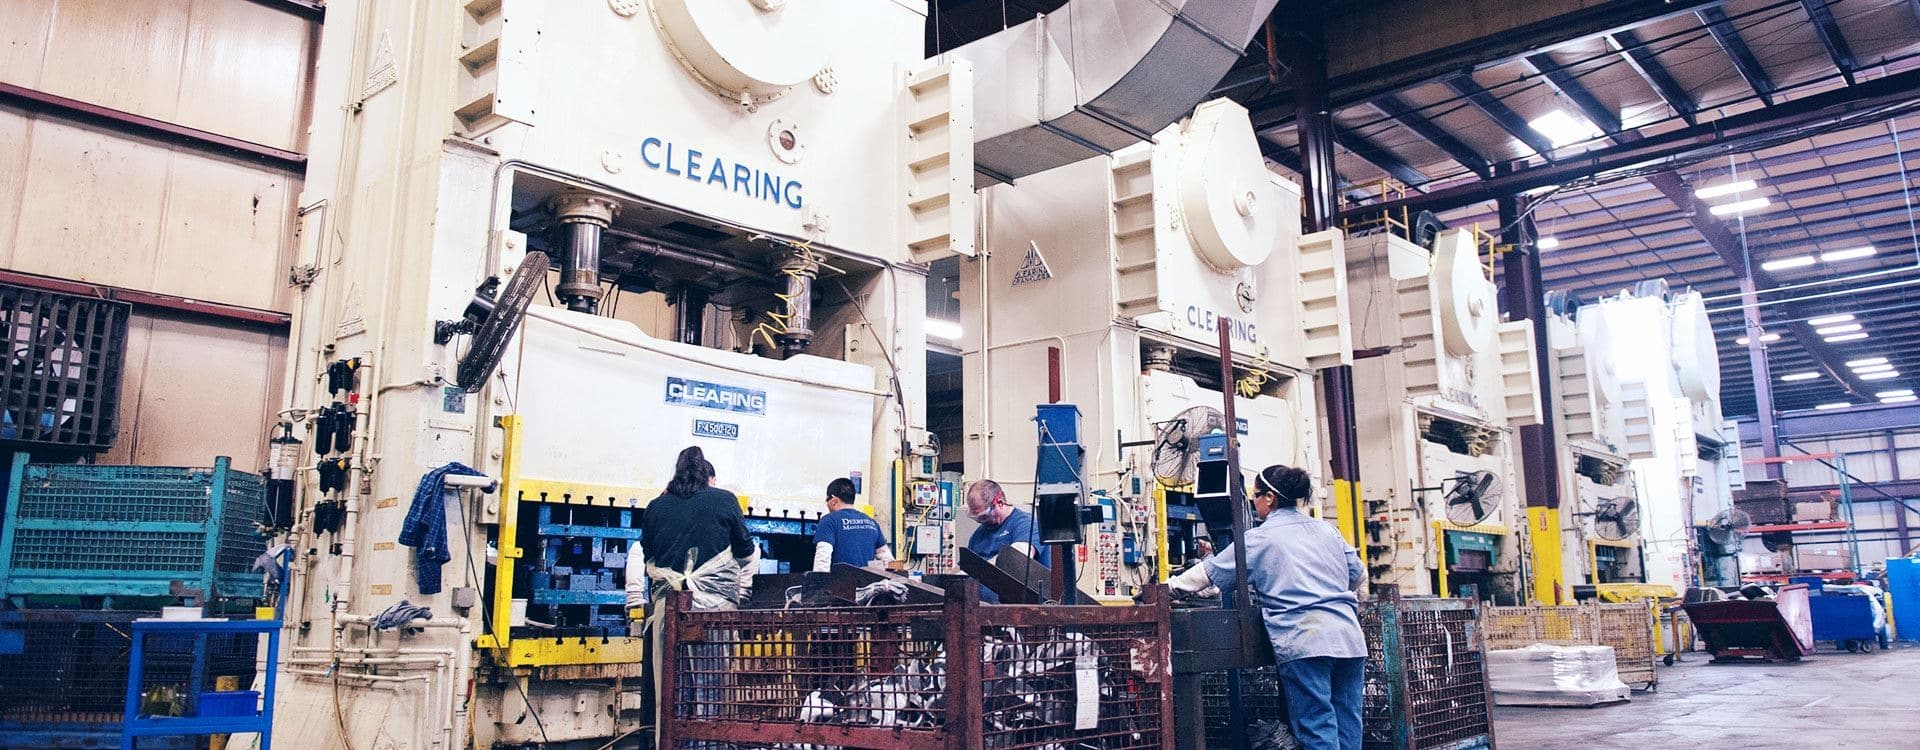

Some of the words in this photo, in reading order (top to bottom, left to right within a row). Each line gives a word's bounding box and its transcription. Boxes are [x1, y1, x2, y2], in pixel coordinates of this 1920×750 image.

[641, 137, 803, 209] CLEARING
[1187, 305, 1257, 343] CLERING
[668, 383, 764, 409] CLEARING
